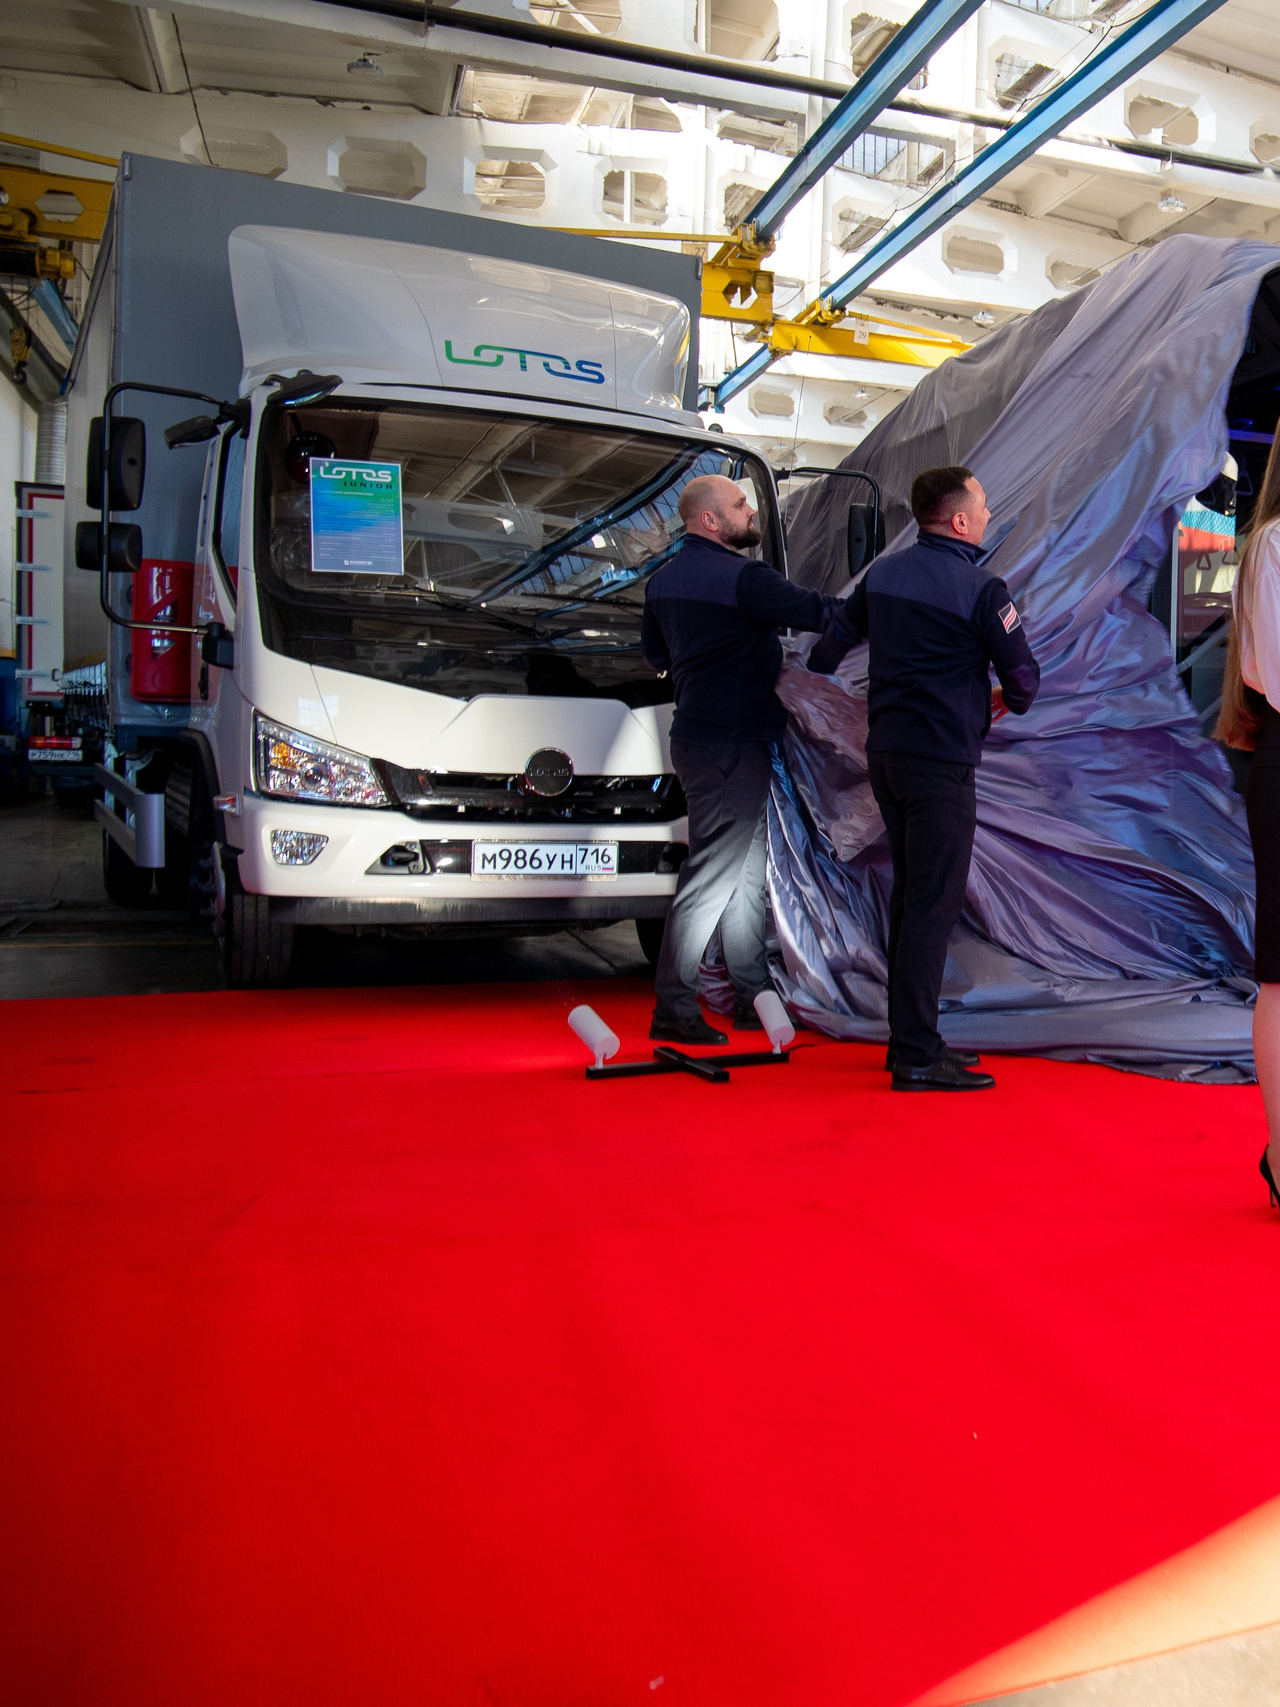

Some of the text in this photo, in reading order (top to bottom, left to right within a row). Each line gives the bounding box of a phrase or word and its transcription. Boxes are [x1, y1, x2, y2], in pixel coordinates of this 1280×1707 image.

[694, 247, 707, 258] 27
[857, 331, 867, 340] 29
[444, 340, 605, 384] LOTOS
[320, 466, 392, 482] LOTOS
[343, 481, 393, 489] JUNIOR
[578, 848, 611, 864] 716
